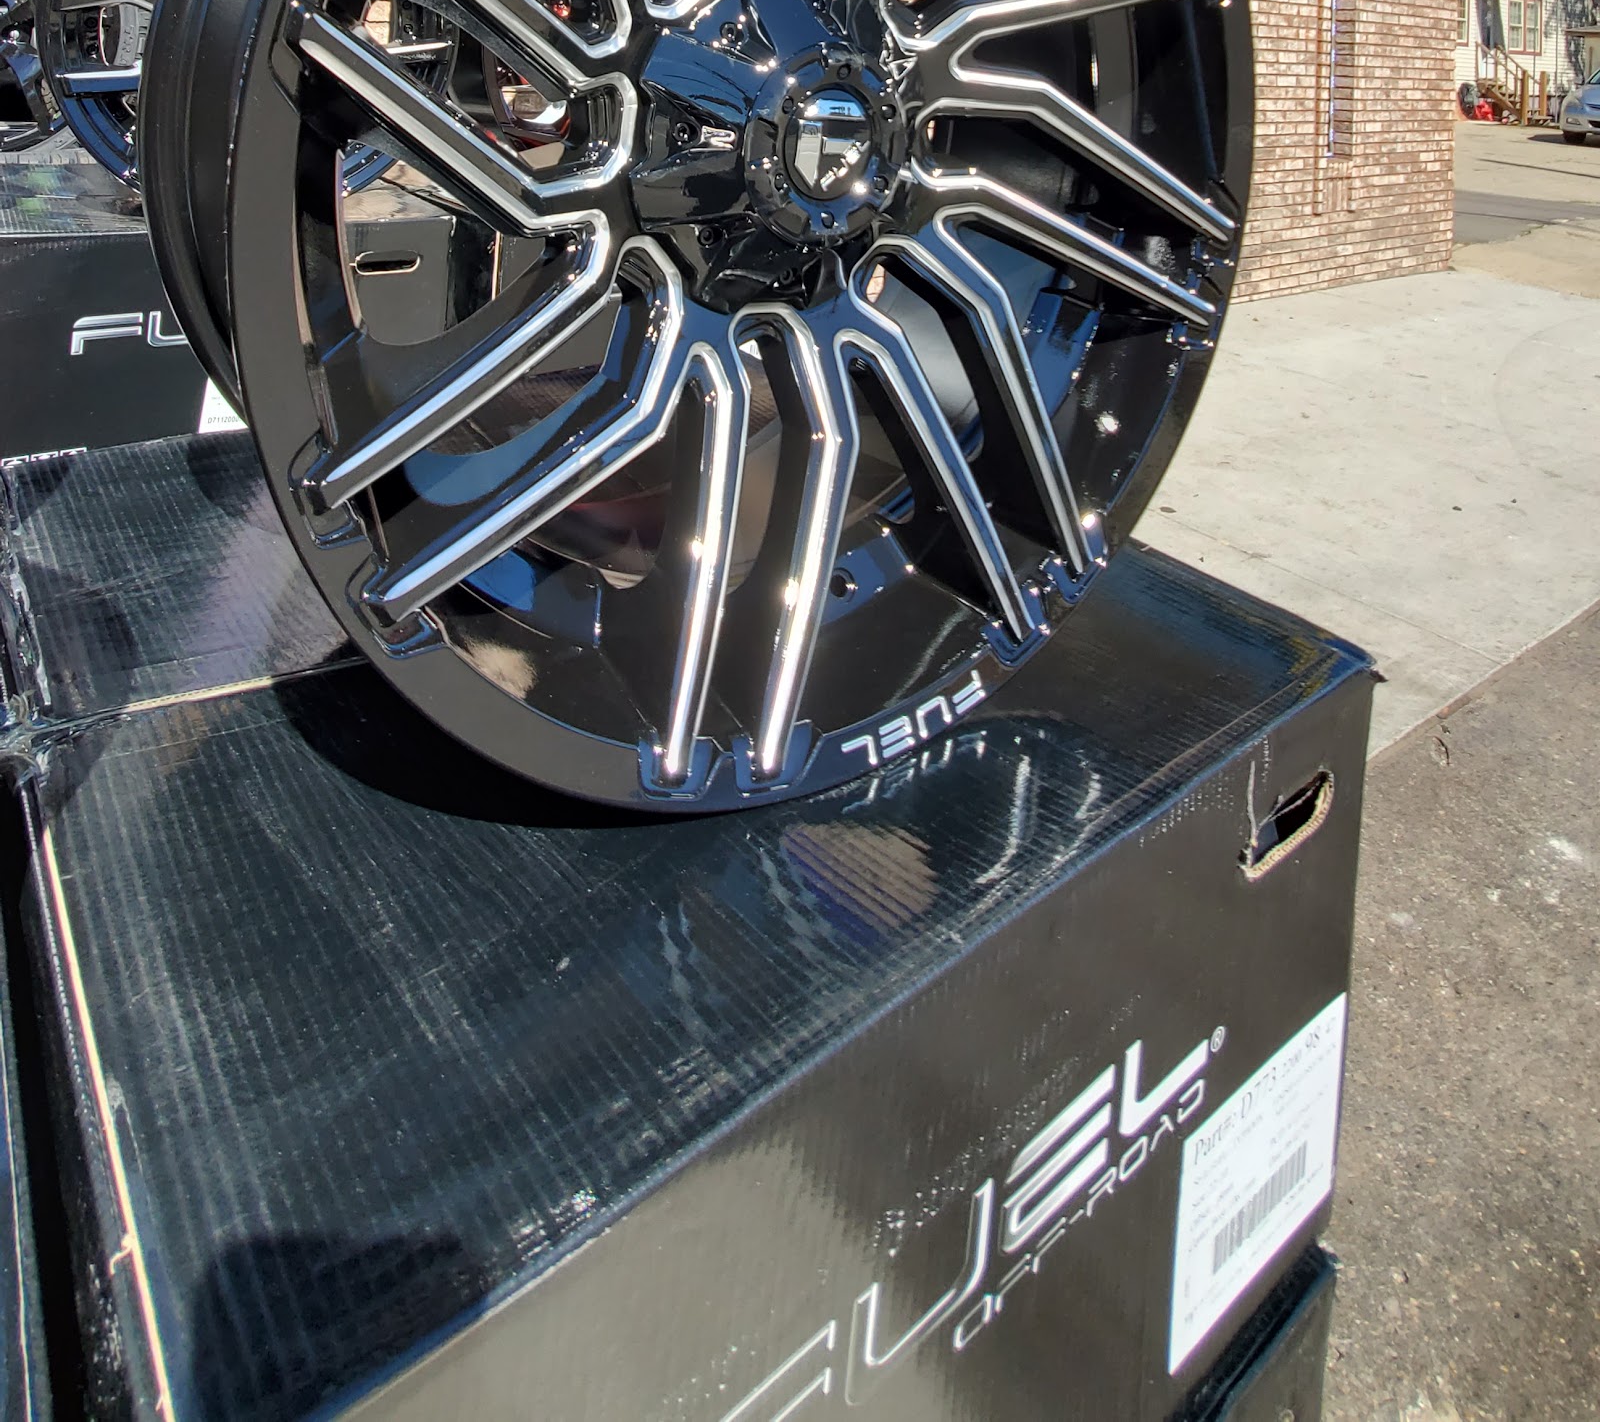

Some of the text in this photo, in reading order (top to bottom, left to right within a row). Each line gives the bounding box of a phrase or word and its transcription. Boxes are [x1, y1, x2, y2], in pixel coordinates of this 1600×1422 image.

[70, 311, 189, 355] FU
[841, 669, 986, 768] FUEL
[953, 1078, 1205, 1351] OFF-ROAD
